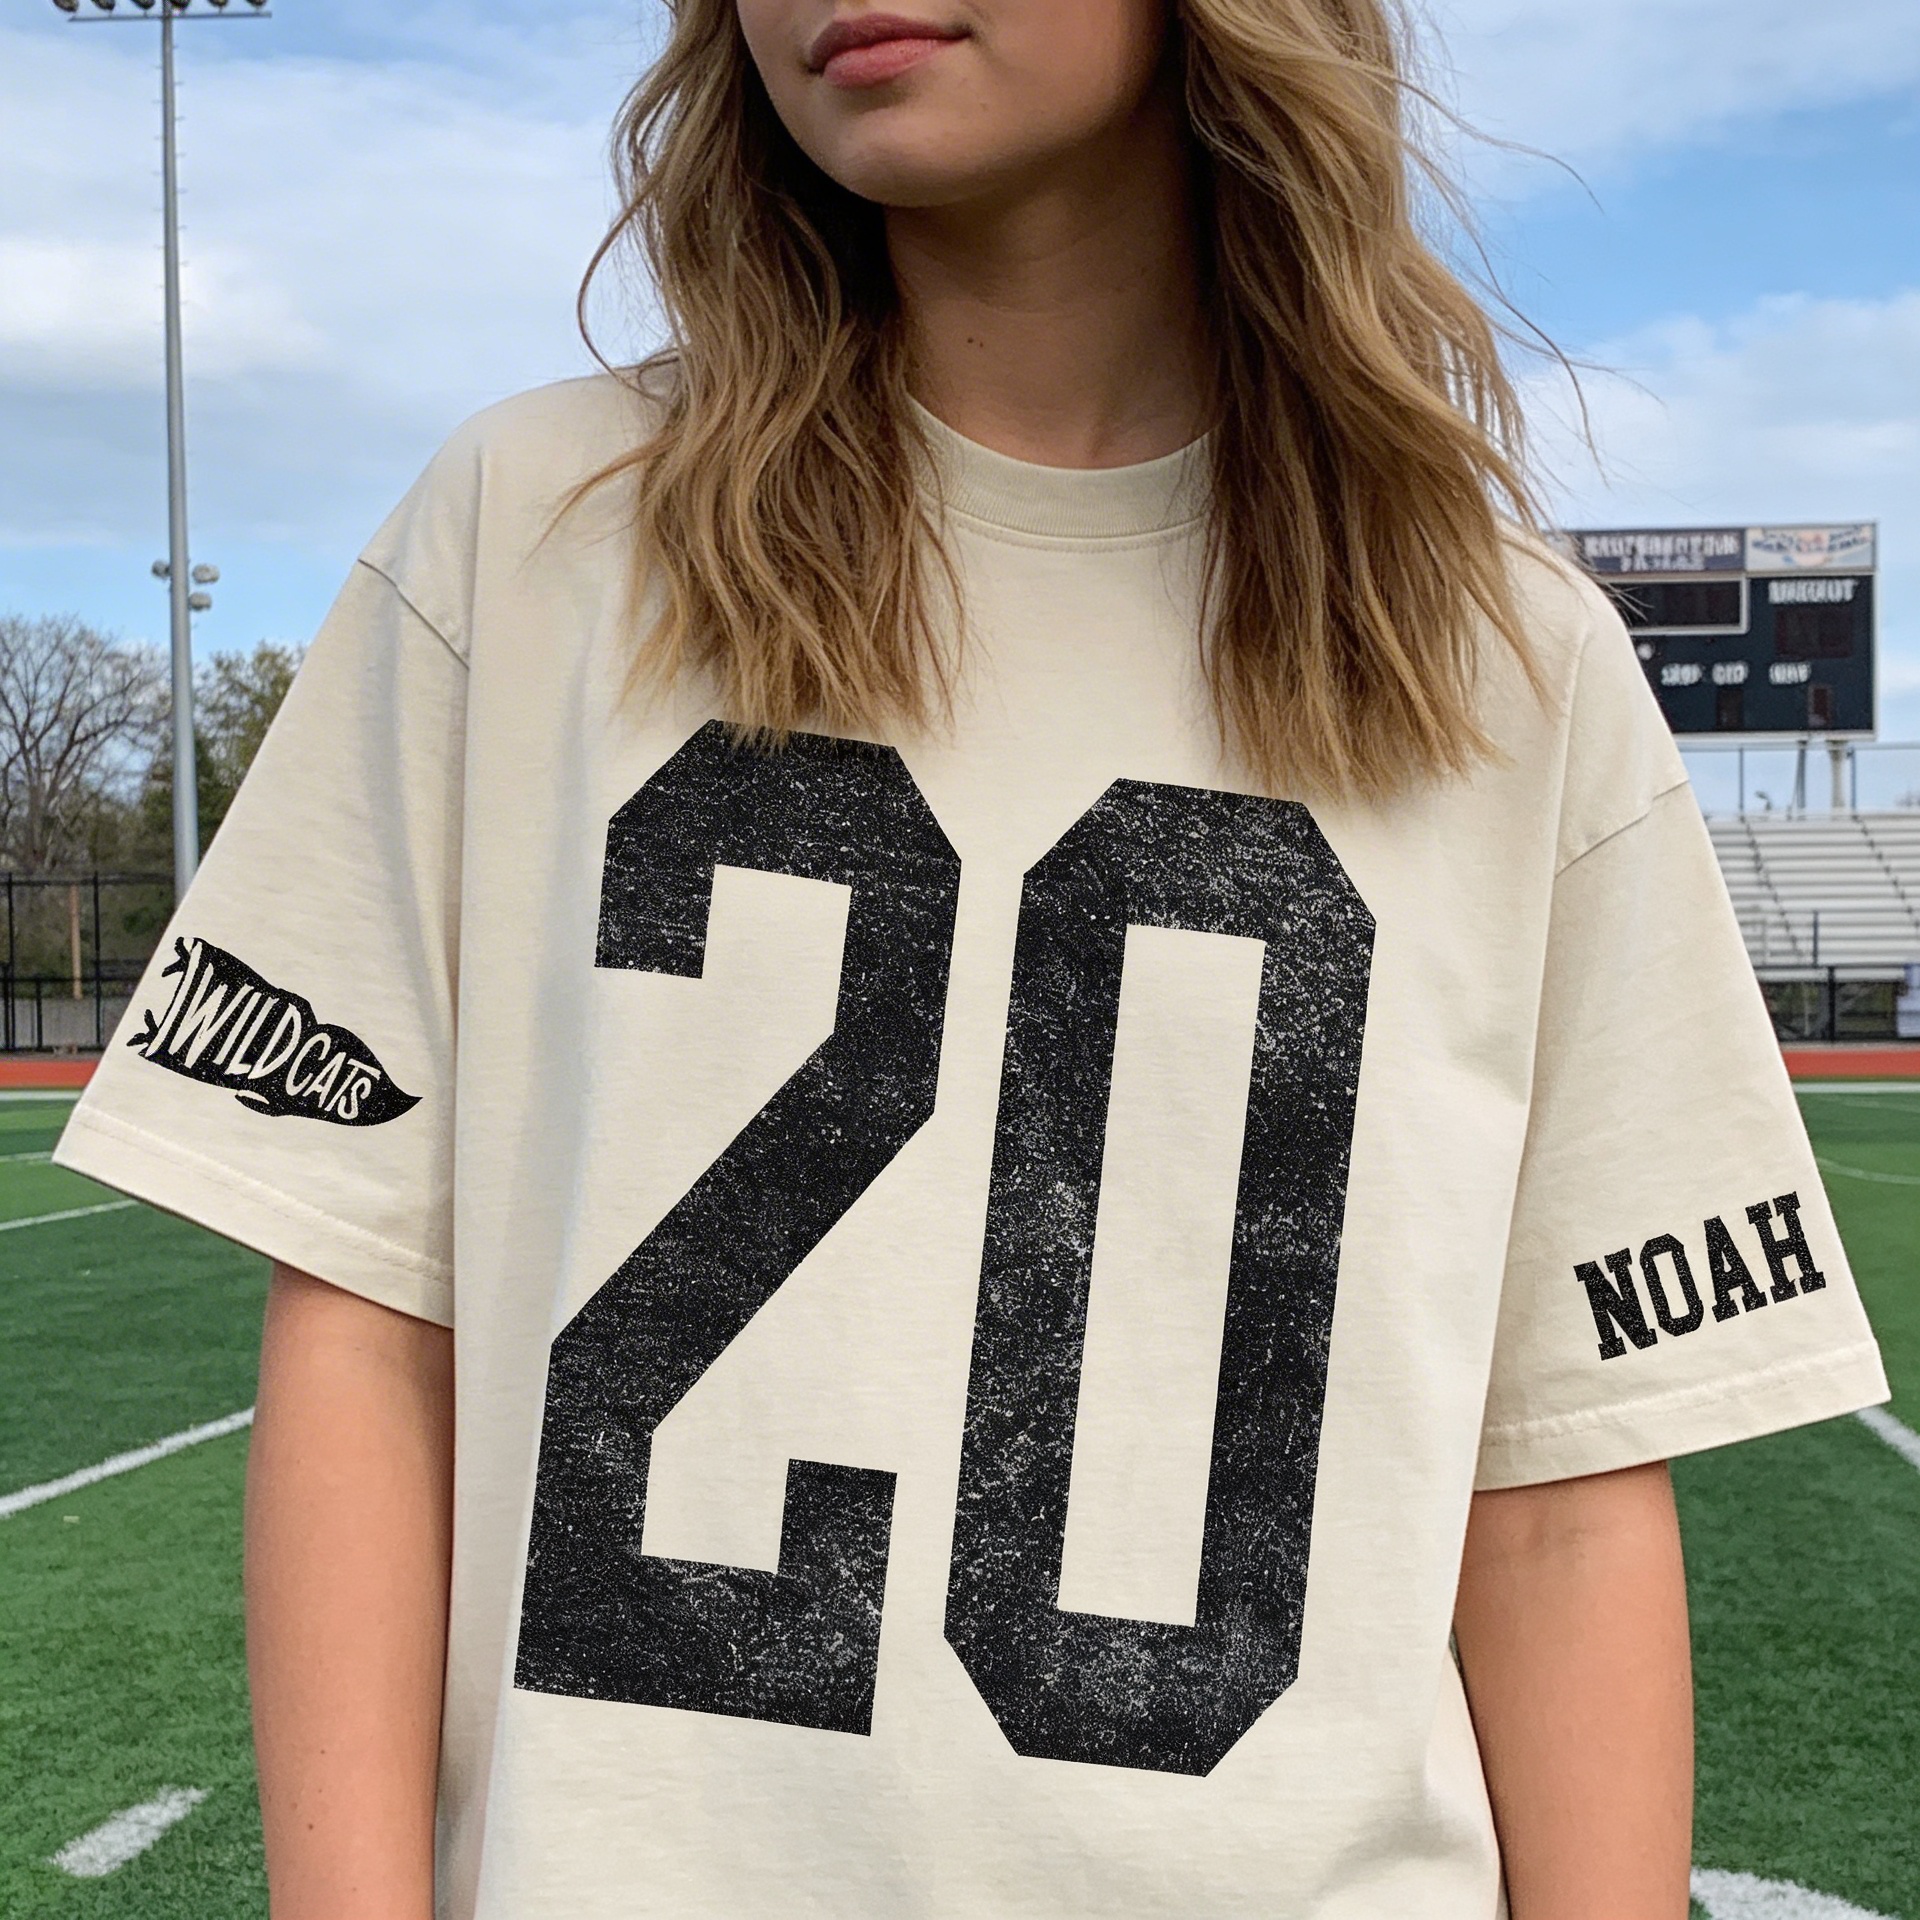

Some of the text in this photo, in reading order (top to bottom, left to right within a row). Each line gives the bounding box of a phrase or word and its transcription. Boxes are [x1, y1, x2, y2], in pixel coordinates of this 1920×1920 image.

[167, 961, 381, 1120] WILDCATS
[514, 719, 1376, 1777] 20
[1573, 1191, 1826, 1361] NOAH
